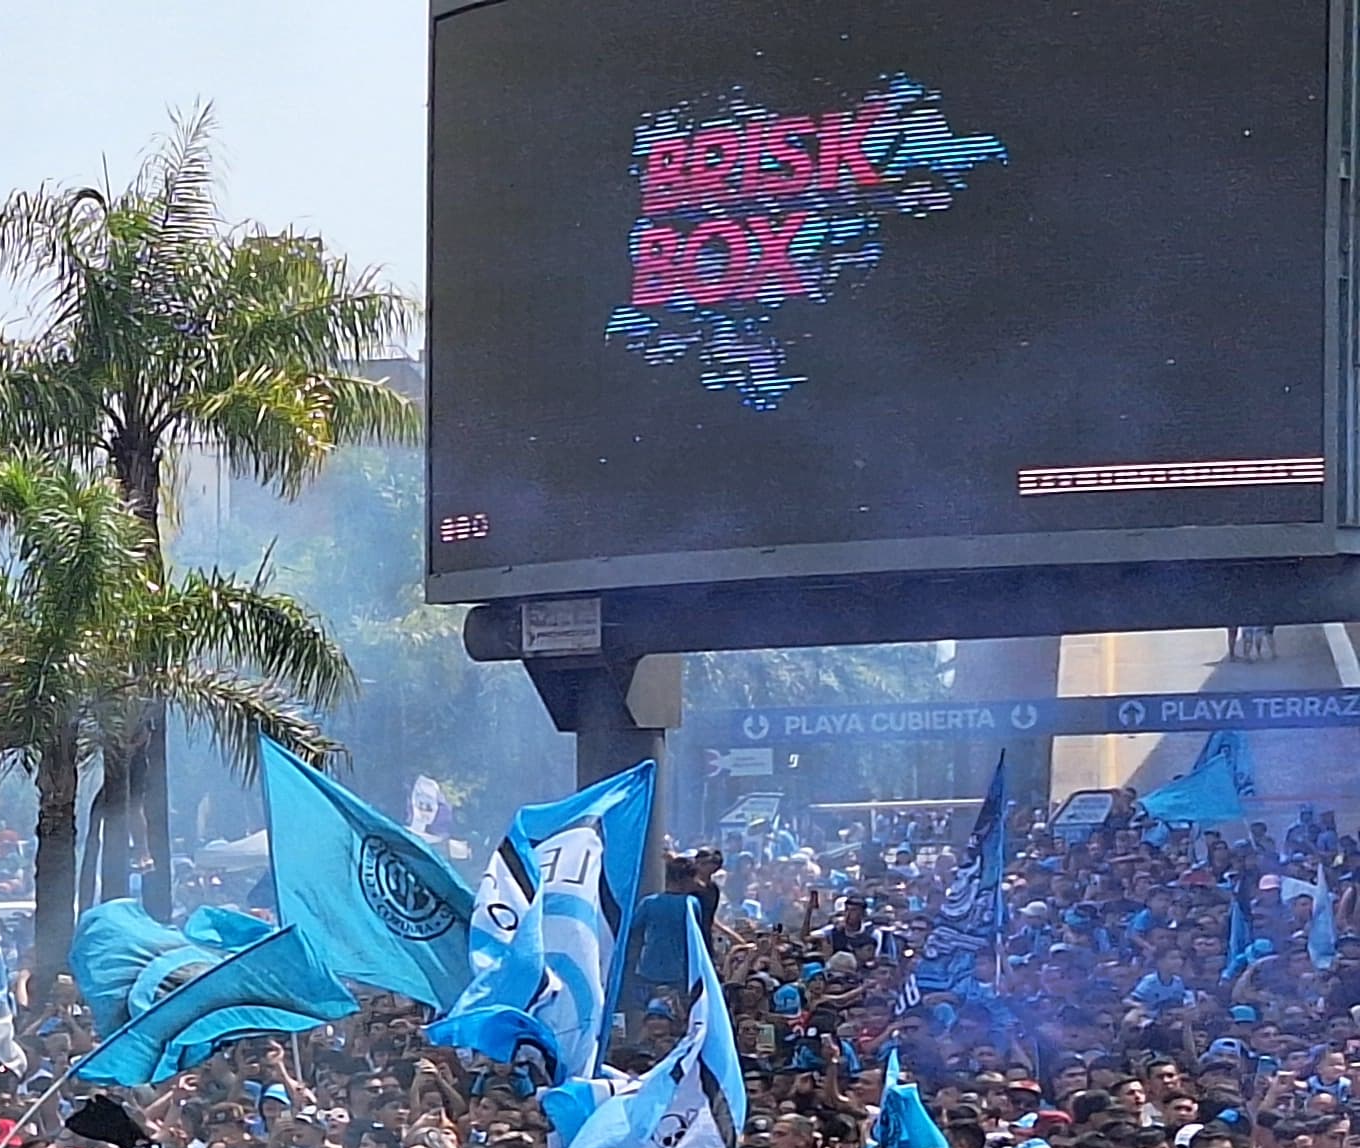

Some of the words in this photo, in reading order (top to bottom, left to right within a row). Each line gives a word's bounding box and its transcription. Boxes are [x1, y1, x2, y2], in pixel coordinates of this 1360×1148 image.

[641, 100, 884, 214] BRISK
[631, 212, 809, 304] BOX
[784, 714, 864, 736] PLAYA
[871, 708, 995, 732] CUBIERTA
[1161, 699, 1245, 722] PLAYA
